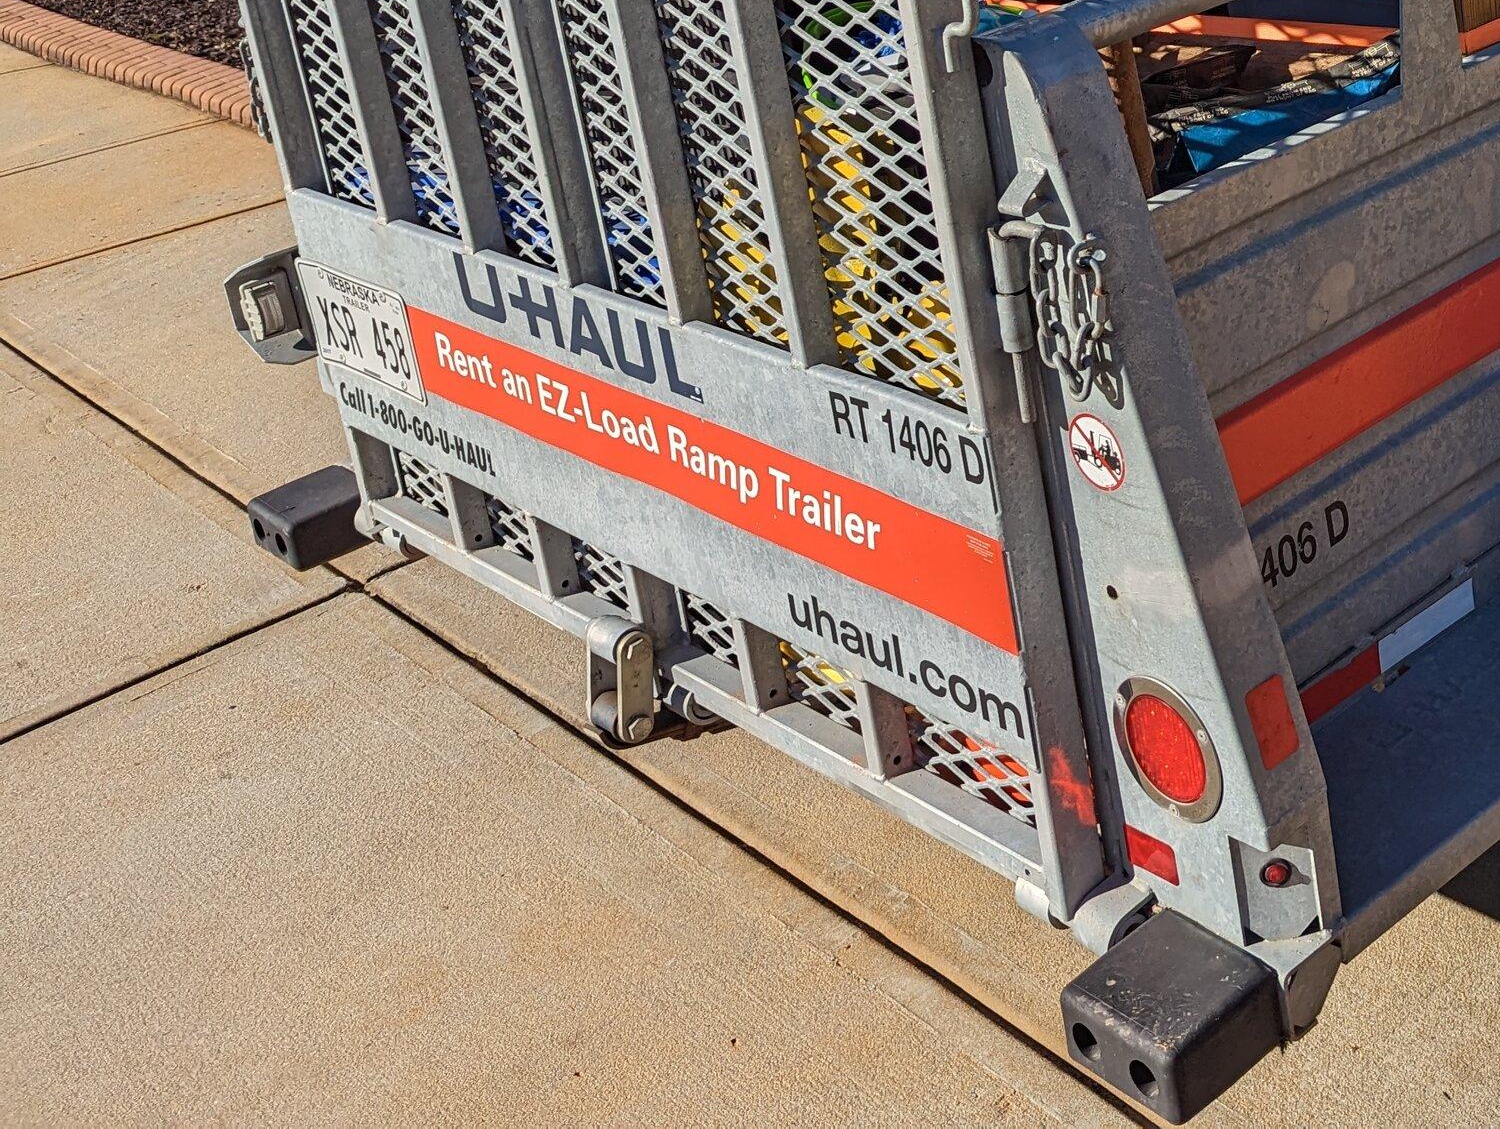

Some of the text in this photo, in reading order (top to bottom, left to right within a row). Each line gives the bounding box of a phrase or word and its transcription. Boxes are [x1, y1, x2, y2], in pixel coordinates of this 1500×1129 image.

[326, 273, 380, 306] NEBRASKA
[342, 294, 371, 313] TRAILER
[452, 251, 704, 404] U-HAUL
[316, 296, 411, 380] XSR 458
[340, 381, 496, 477] Call 1-800-GO-U-HAUL
[434, 331, 881, 550] Rent an EZ-Load Ramp Trailer
[828, 390, 985, 485] RT 1406 D
[1324, 500, 1349, 548] D
[787, 593, 1025, 740] uhaul.com
